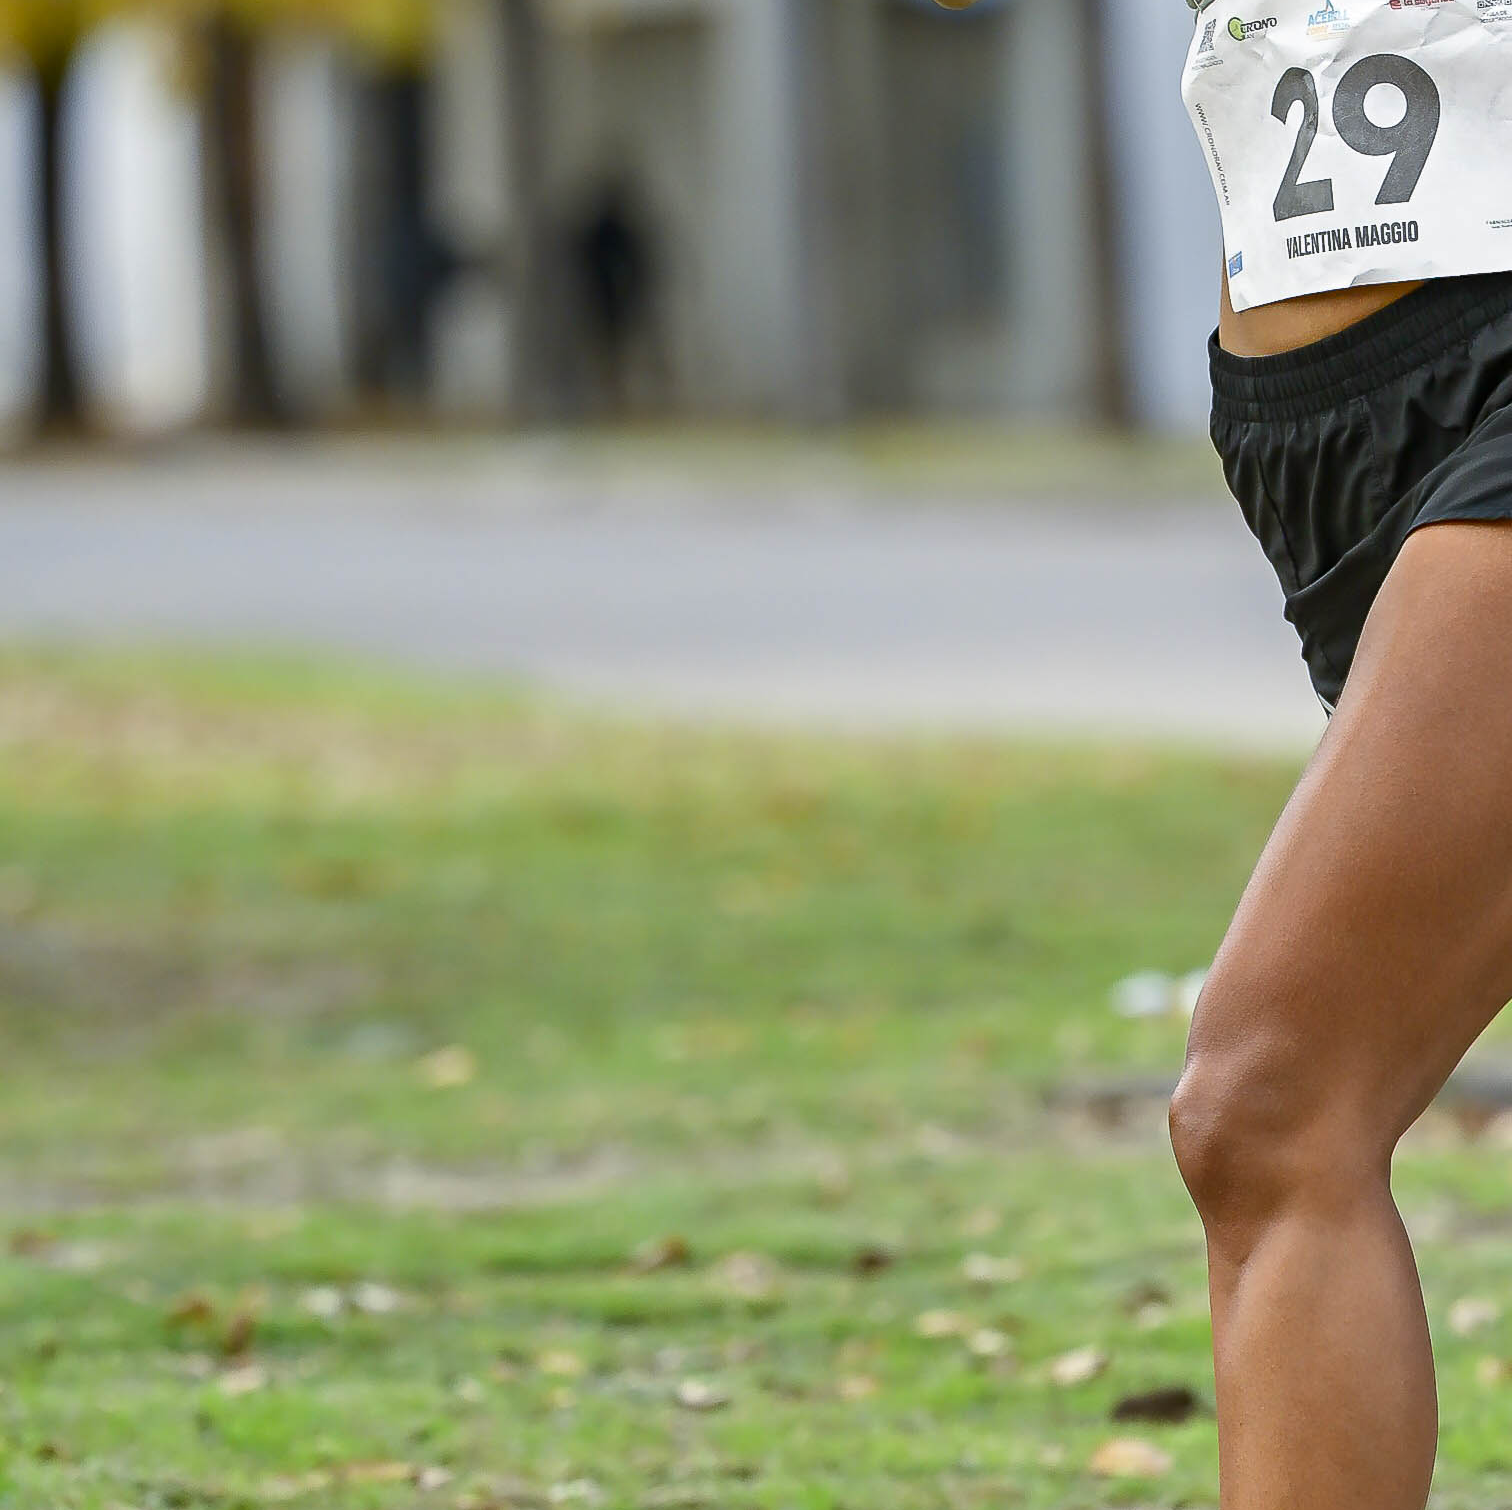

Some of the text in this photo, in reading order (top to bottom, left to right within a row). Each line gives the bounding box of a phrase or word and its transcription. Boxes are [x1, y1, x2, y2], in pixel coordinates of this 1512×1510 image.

[1270, 53, 1441, 222] 29
[1286, 220, 1419, 259] VALENTINA MAGGIO
